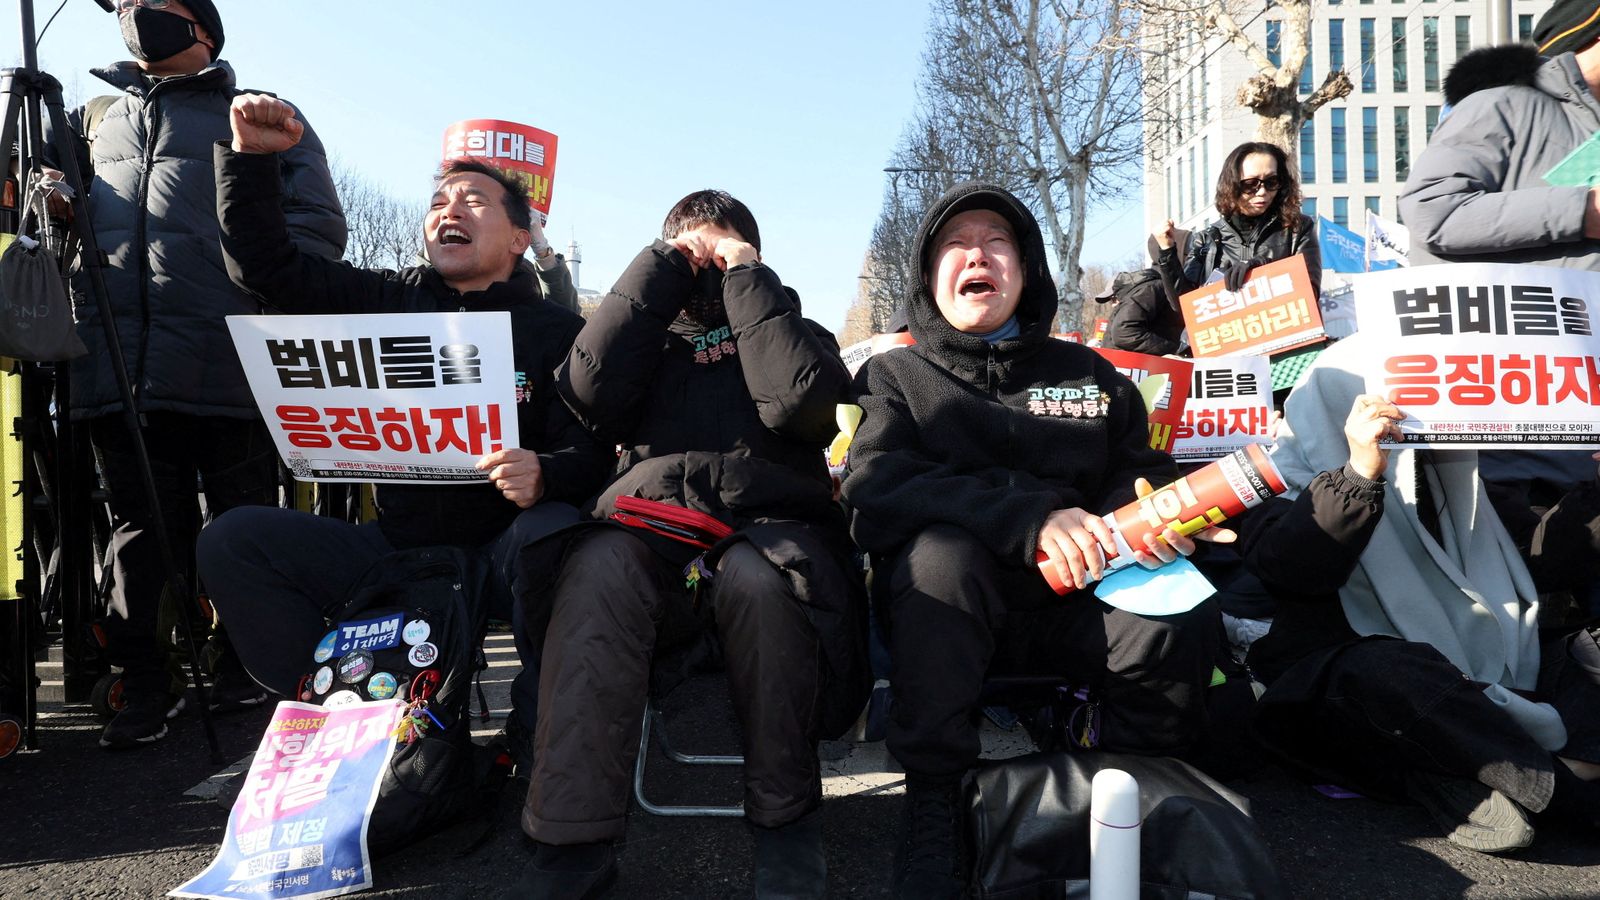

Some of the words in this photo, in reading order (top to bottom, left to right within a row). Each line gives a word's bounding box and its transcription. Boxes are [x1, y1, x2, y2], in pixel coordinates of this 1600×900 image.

[1194, 298, 1311, 355] 탄핵하라!
[1392, 285, 1593, 336] 법비들을
[266, 336, 482, 389] 법비들을
[275, 404, 502, 455] 응징하자!
[1430, 423, 1464, 432] 내란청산!
[1467, 423, 1513, 432] 국민주권실현!
[1515, 423, 1566, 432] 촛불대행진으로
[1568, 423, 1593, 432] 모이자!
[341, 629, 397, 650] 이재명
[342, 618, 400, 639] TEAM
[277, 817, 328, 846] 제정
